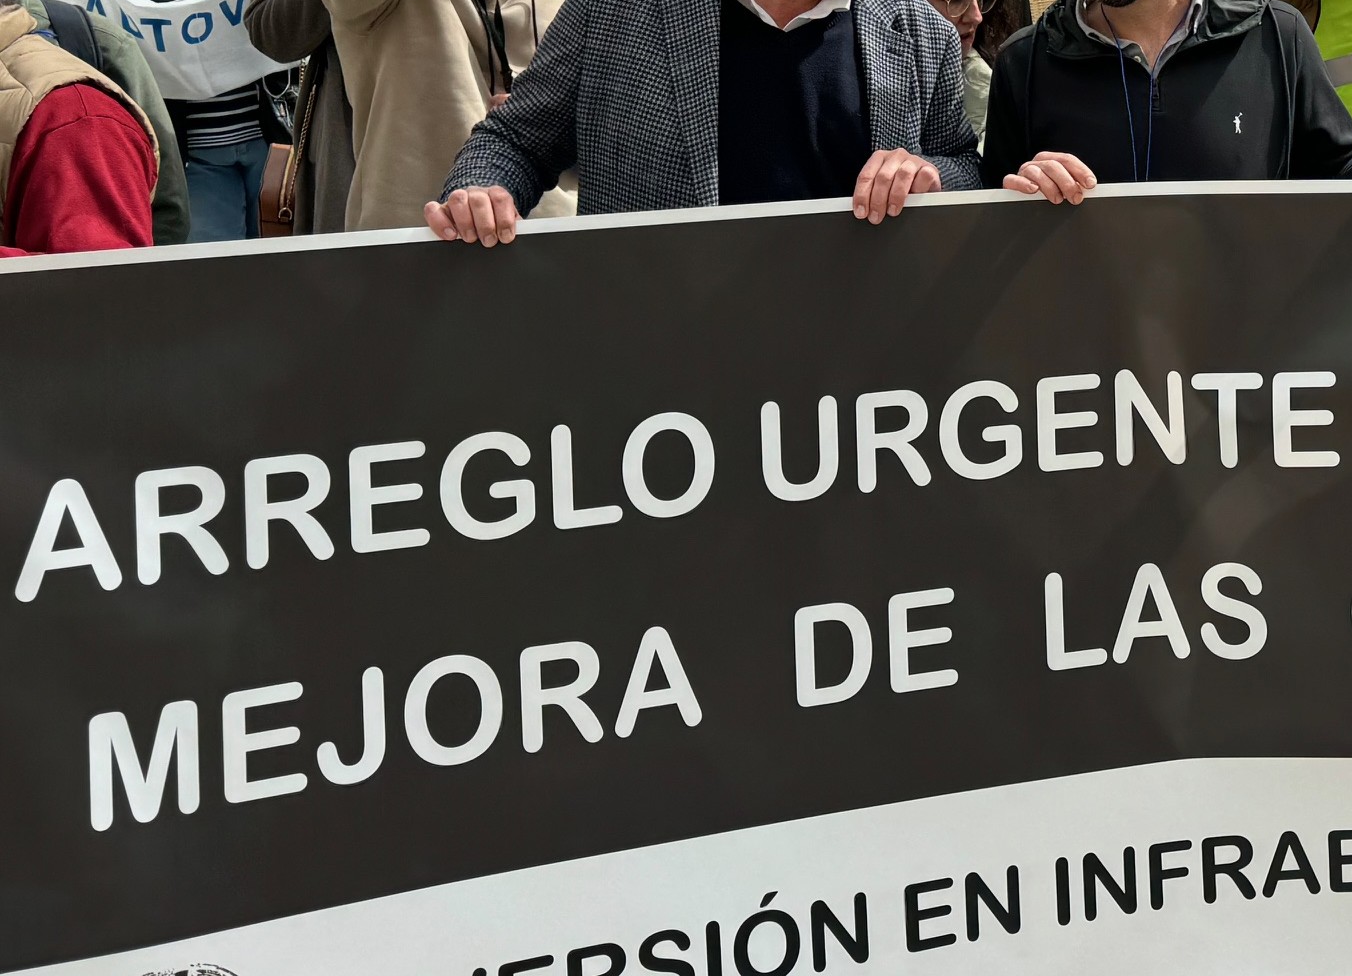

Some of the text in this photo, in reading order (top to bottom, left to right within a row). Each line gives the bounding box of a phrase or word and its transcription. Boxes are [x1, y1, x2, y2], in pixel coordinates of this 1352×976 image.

[14, 411, 716, 603] ARREGLO
[760, 368, 1341, 502] URGENTE
[88, 626, 703, 832] MEJORA
[794, 587, 959, 708] DE
[1044, 562, 1268, 671] LAS
[904, 865, 1021, 953] EN
